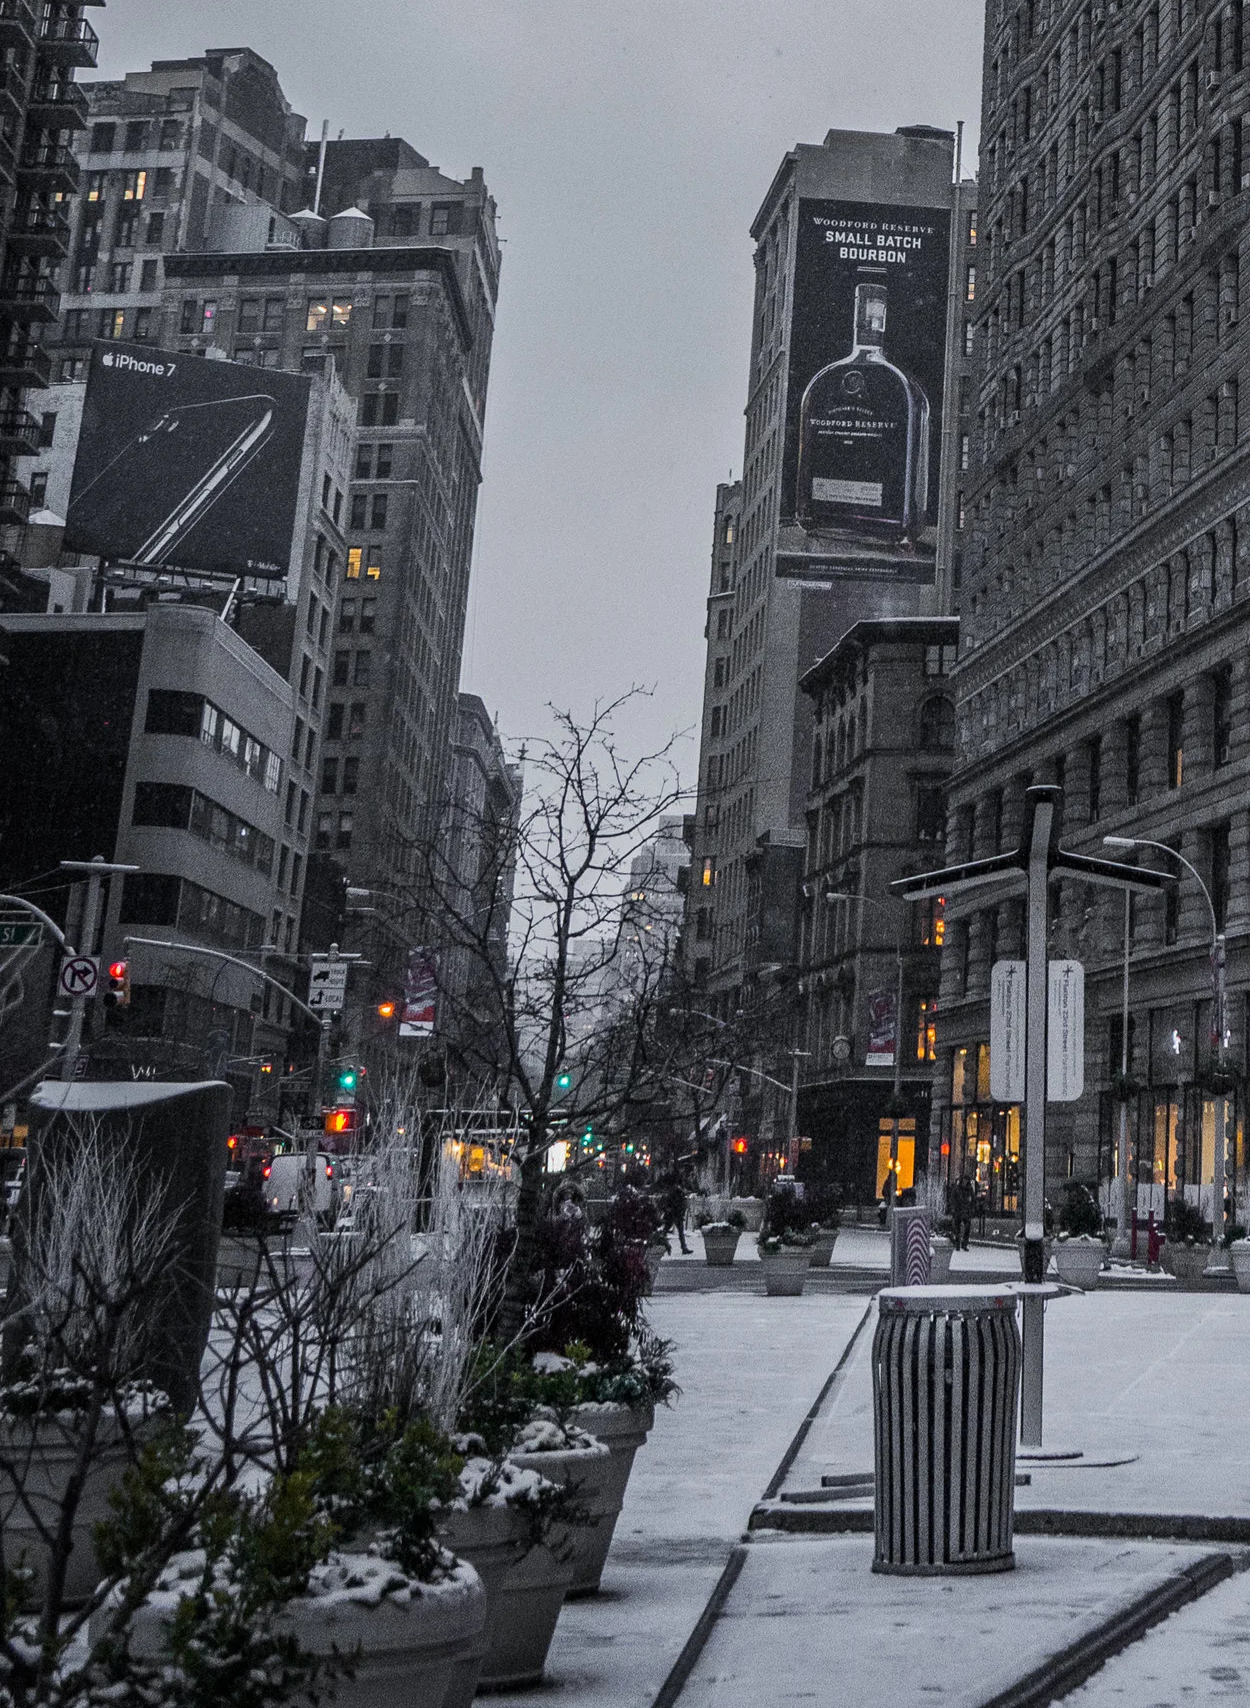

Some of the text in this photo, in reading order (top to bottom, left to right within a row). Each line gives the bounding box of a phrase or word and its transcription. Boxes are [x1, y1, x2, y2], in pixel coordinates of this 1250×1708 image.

[813, 217, 935, 234] WOODFORD RESERVE
[825, 231, 921, 249] SMALL BATCH
[839, 247, 906, 263] BOURBON
[115, 354, 176, 376] iPhone 7
[809, 418, 853, 428] WOODFORD
